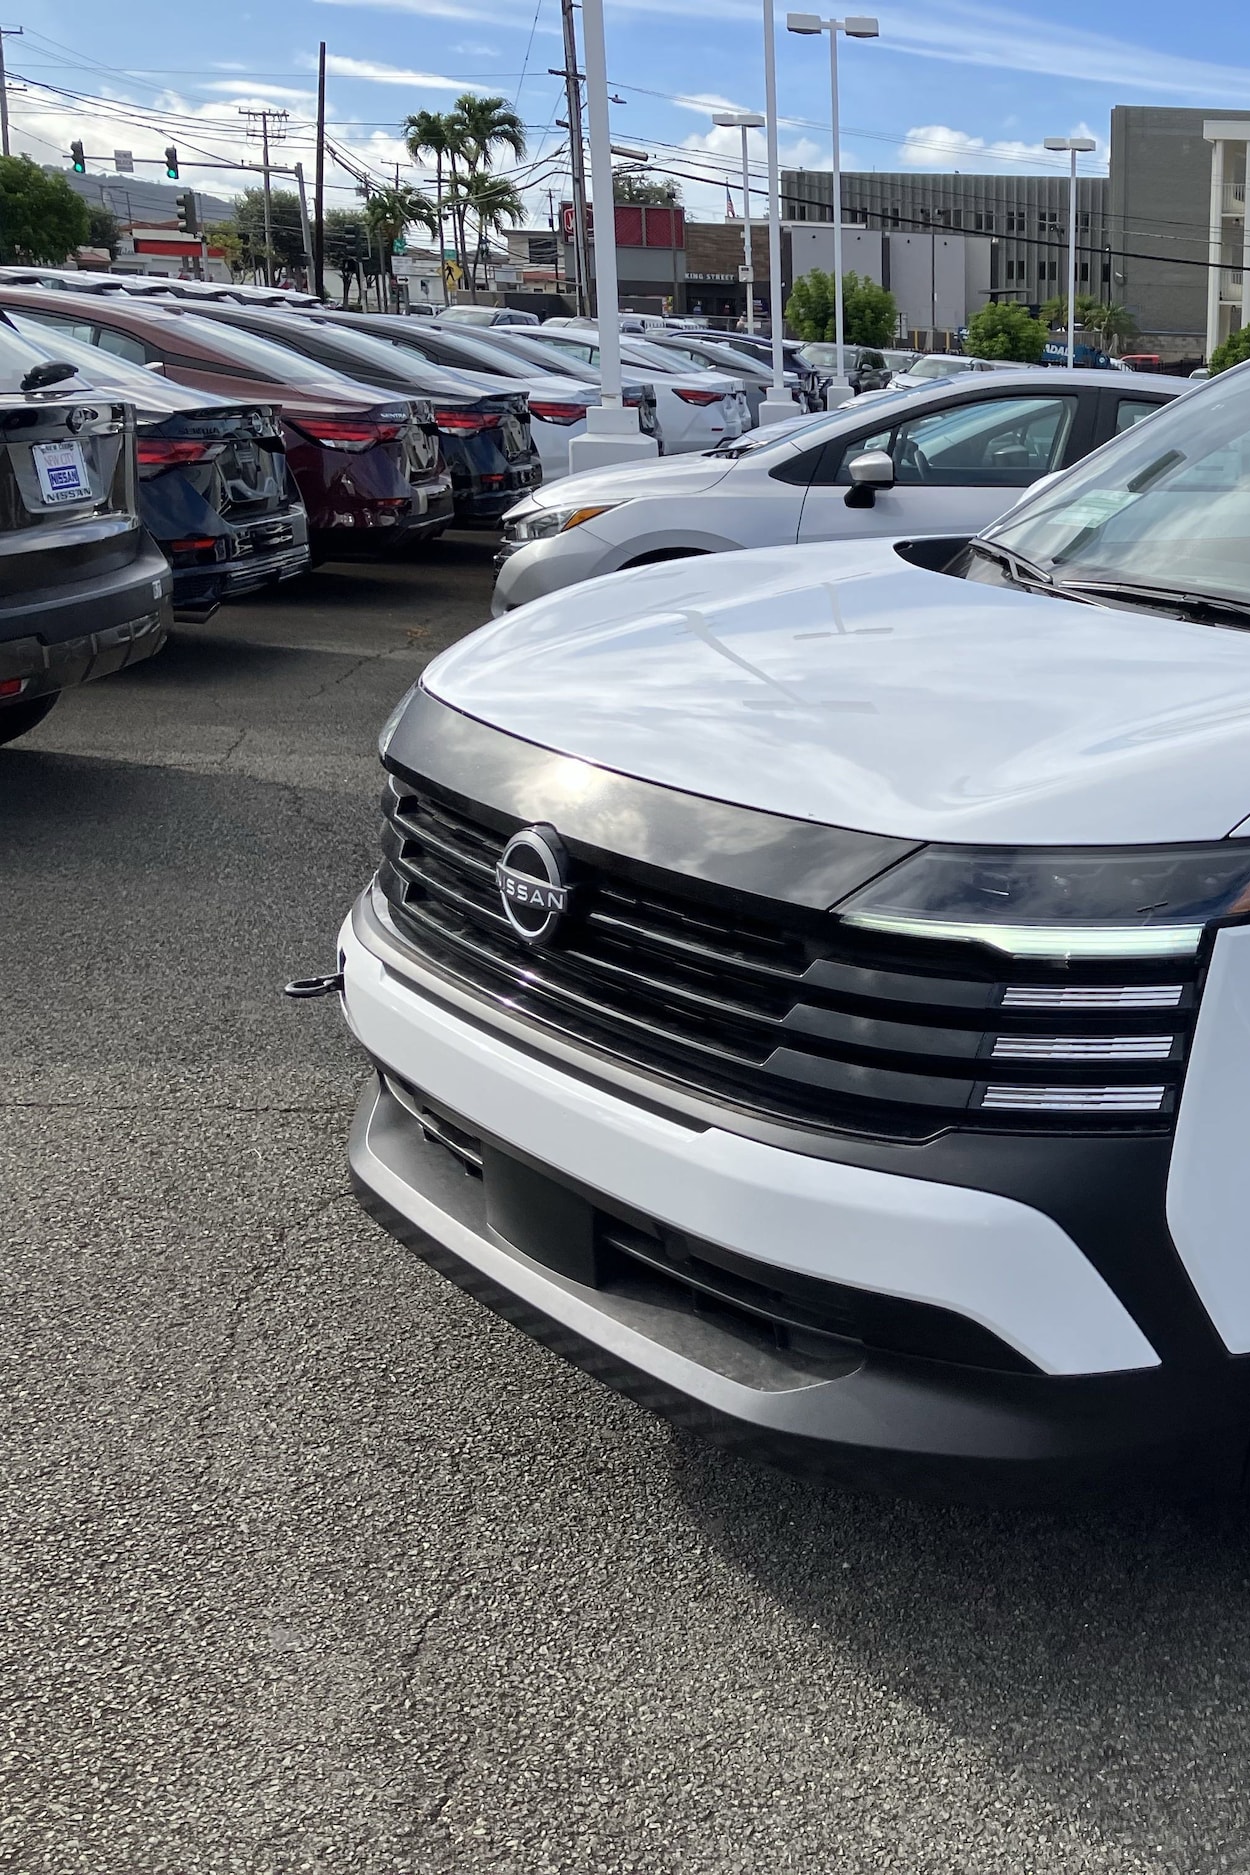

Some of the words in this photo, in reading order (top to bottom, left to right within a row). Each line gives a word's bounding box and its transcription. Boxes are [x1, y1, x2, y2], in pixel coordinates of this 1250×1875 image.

[49, 470, 79, 486] NISSAN
[46, 487, 92, 502] NISSAN
[496, 867, 564, 910] NISSAN
